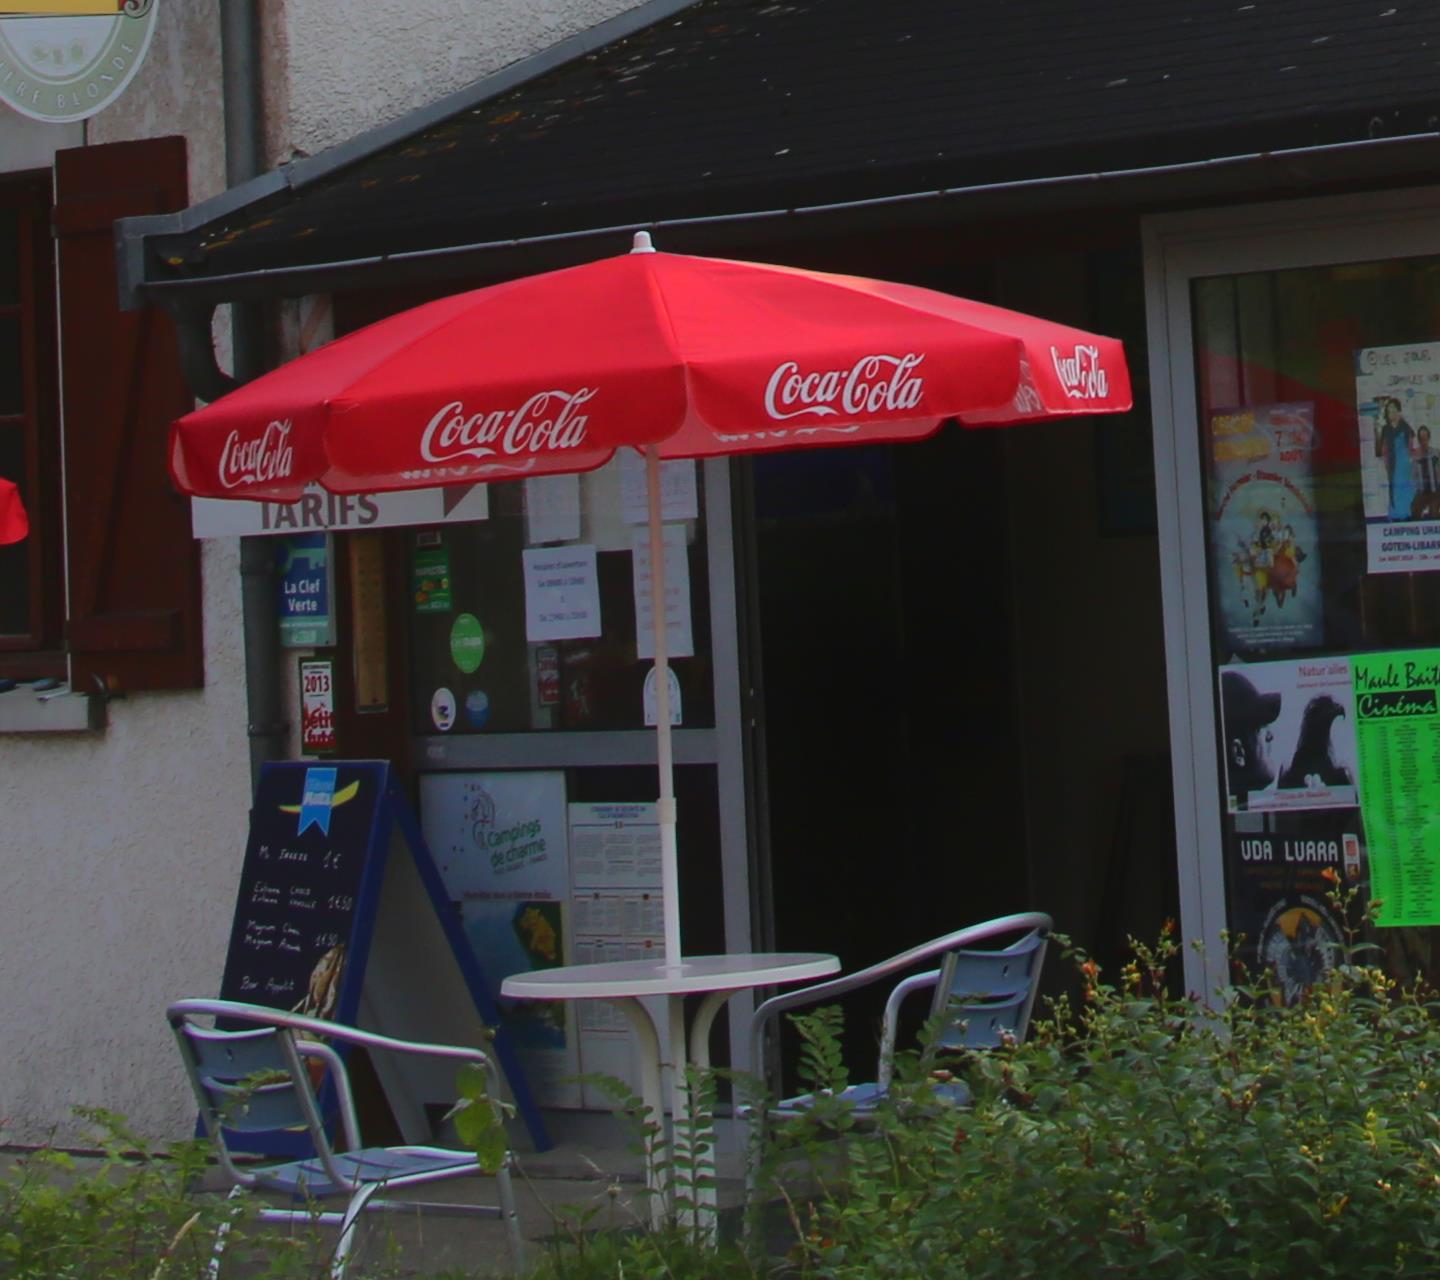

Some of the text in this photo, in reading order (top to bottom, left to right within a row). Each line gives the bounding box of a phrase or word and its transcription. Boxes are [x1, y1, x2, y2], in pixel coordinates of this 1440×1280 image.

[284, 579, 321, 595] La Clef
[287, 598, 318, 612] Verte
[304, 673, 330, 693] 2013
[1355, 664, 1400, 691] Maule
[1358, 693, 1437, 717] Cinéma
[487, 818, 542, 848] Campings
[490, 850, 505, 868] de
[1241, 840, 1273, 861] UDA
